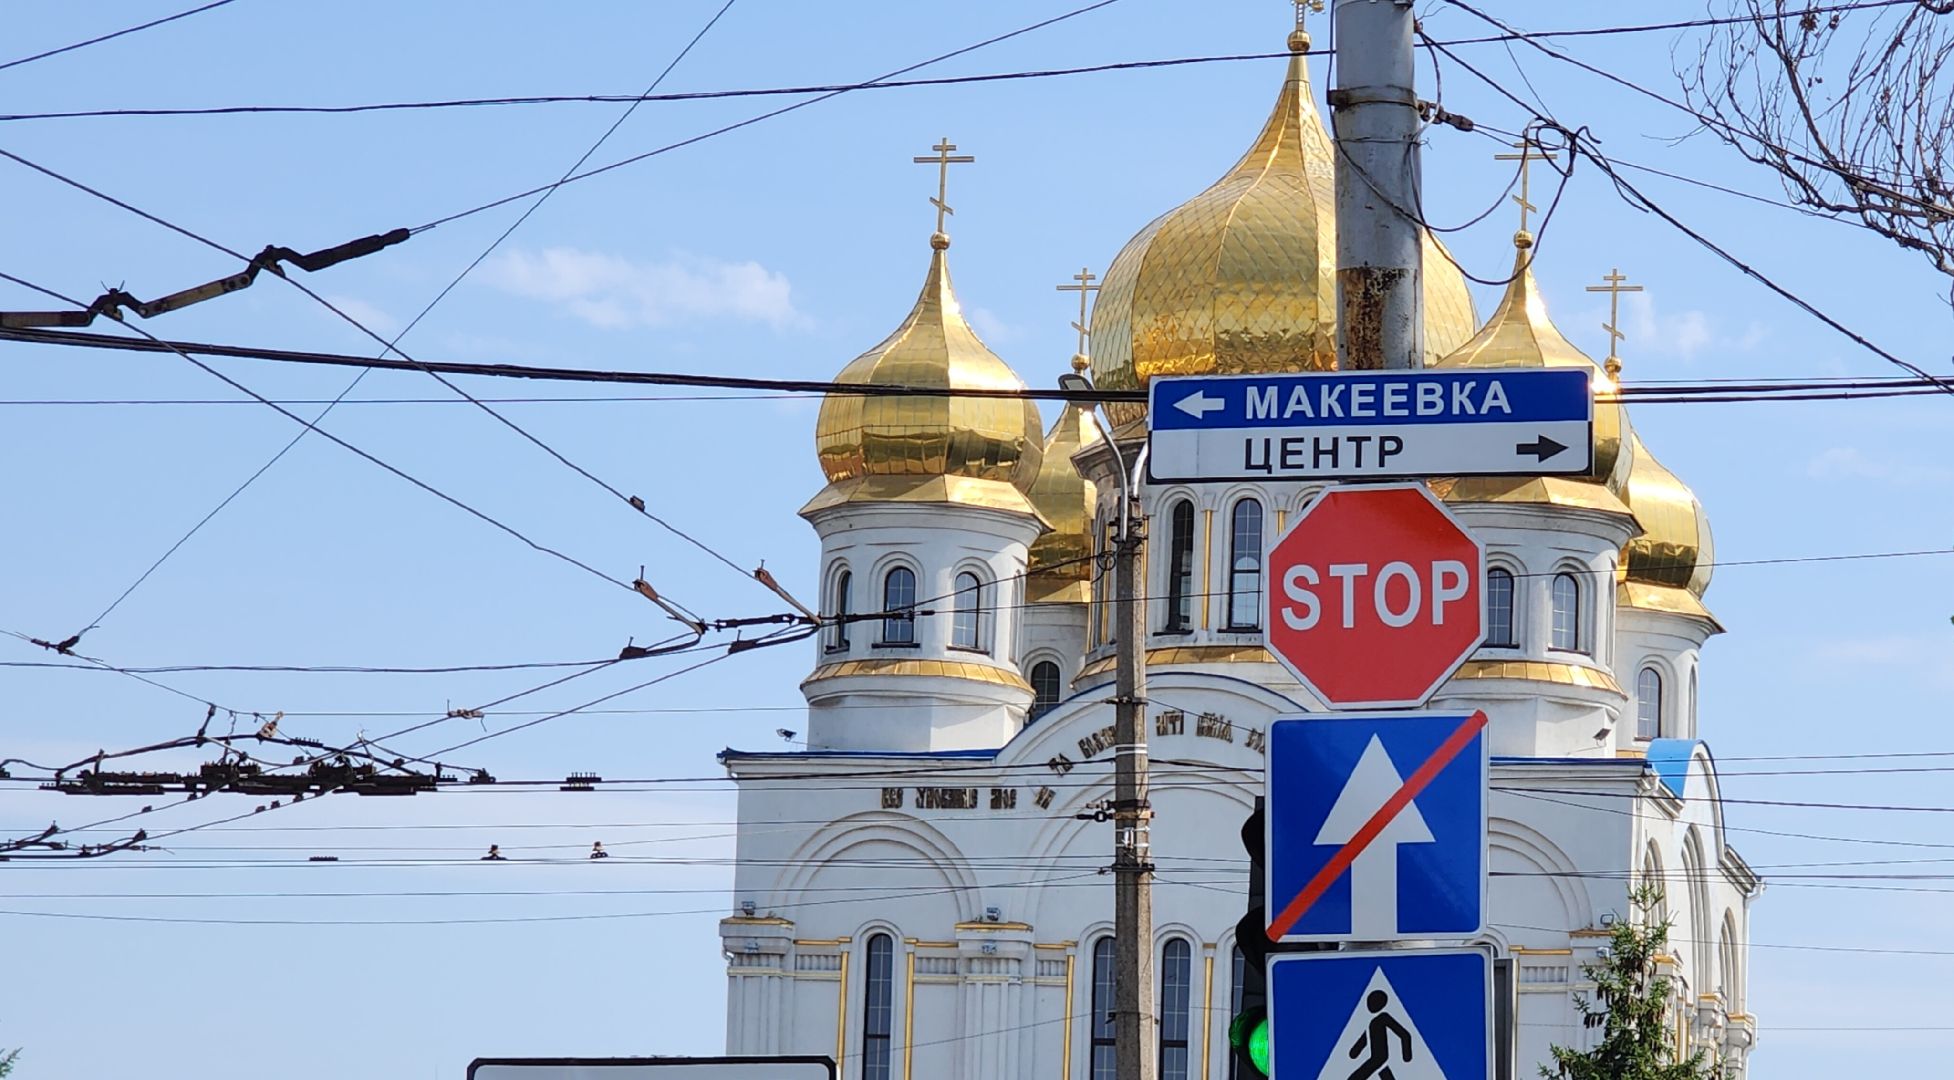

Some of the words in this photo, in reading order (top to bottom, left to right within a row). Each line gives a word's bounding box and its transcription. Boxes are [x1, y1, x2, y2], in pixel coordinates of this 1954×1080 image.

[1245, 380, 1512, 420] МАКЕЕВКА
[1244, 435, 1404, 474] ЦЕНТР
[1281, 559, 1470, 631] STOP
